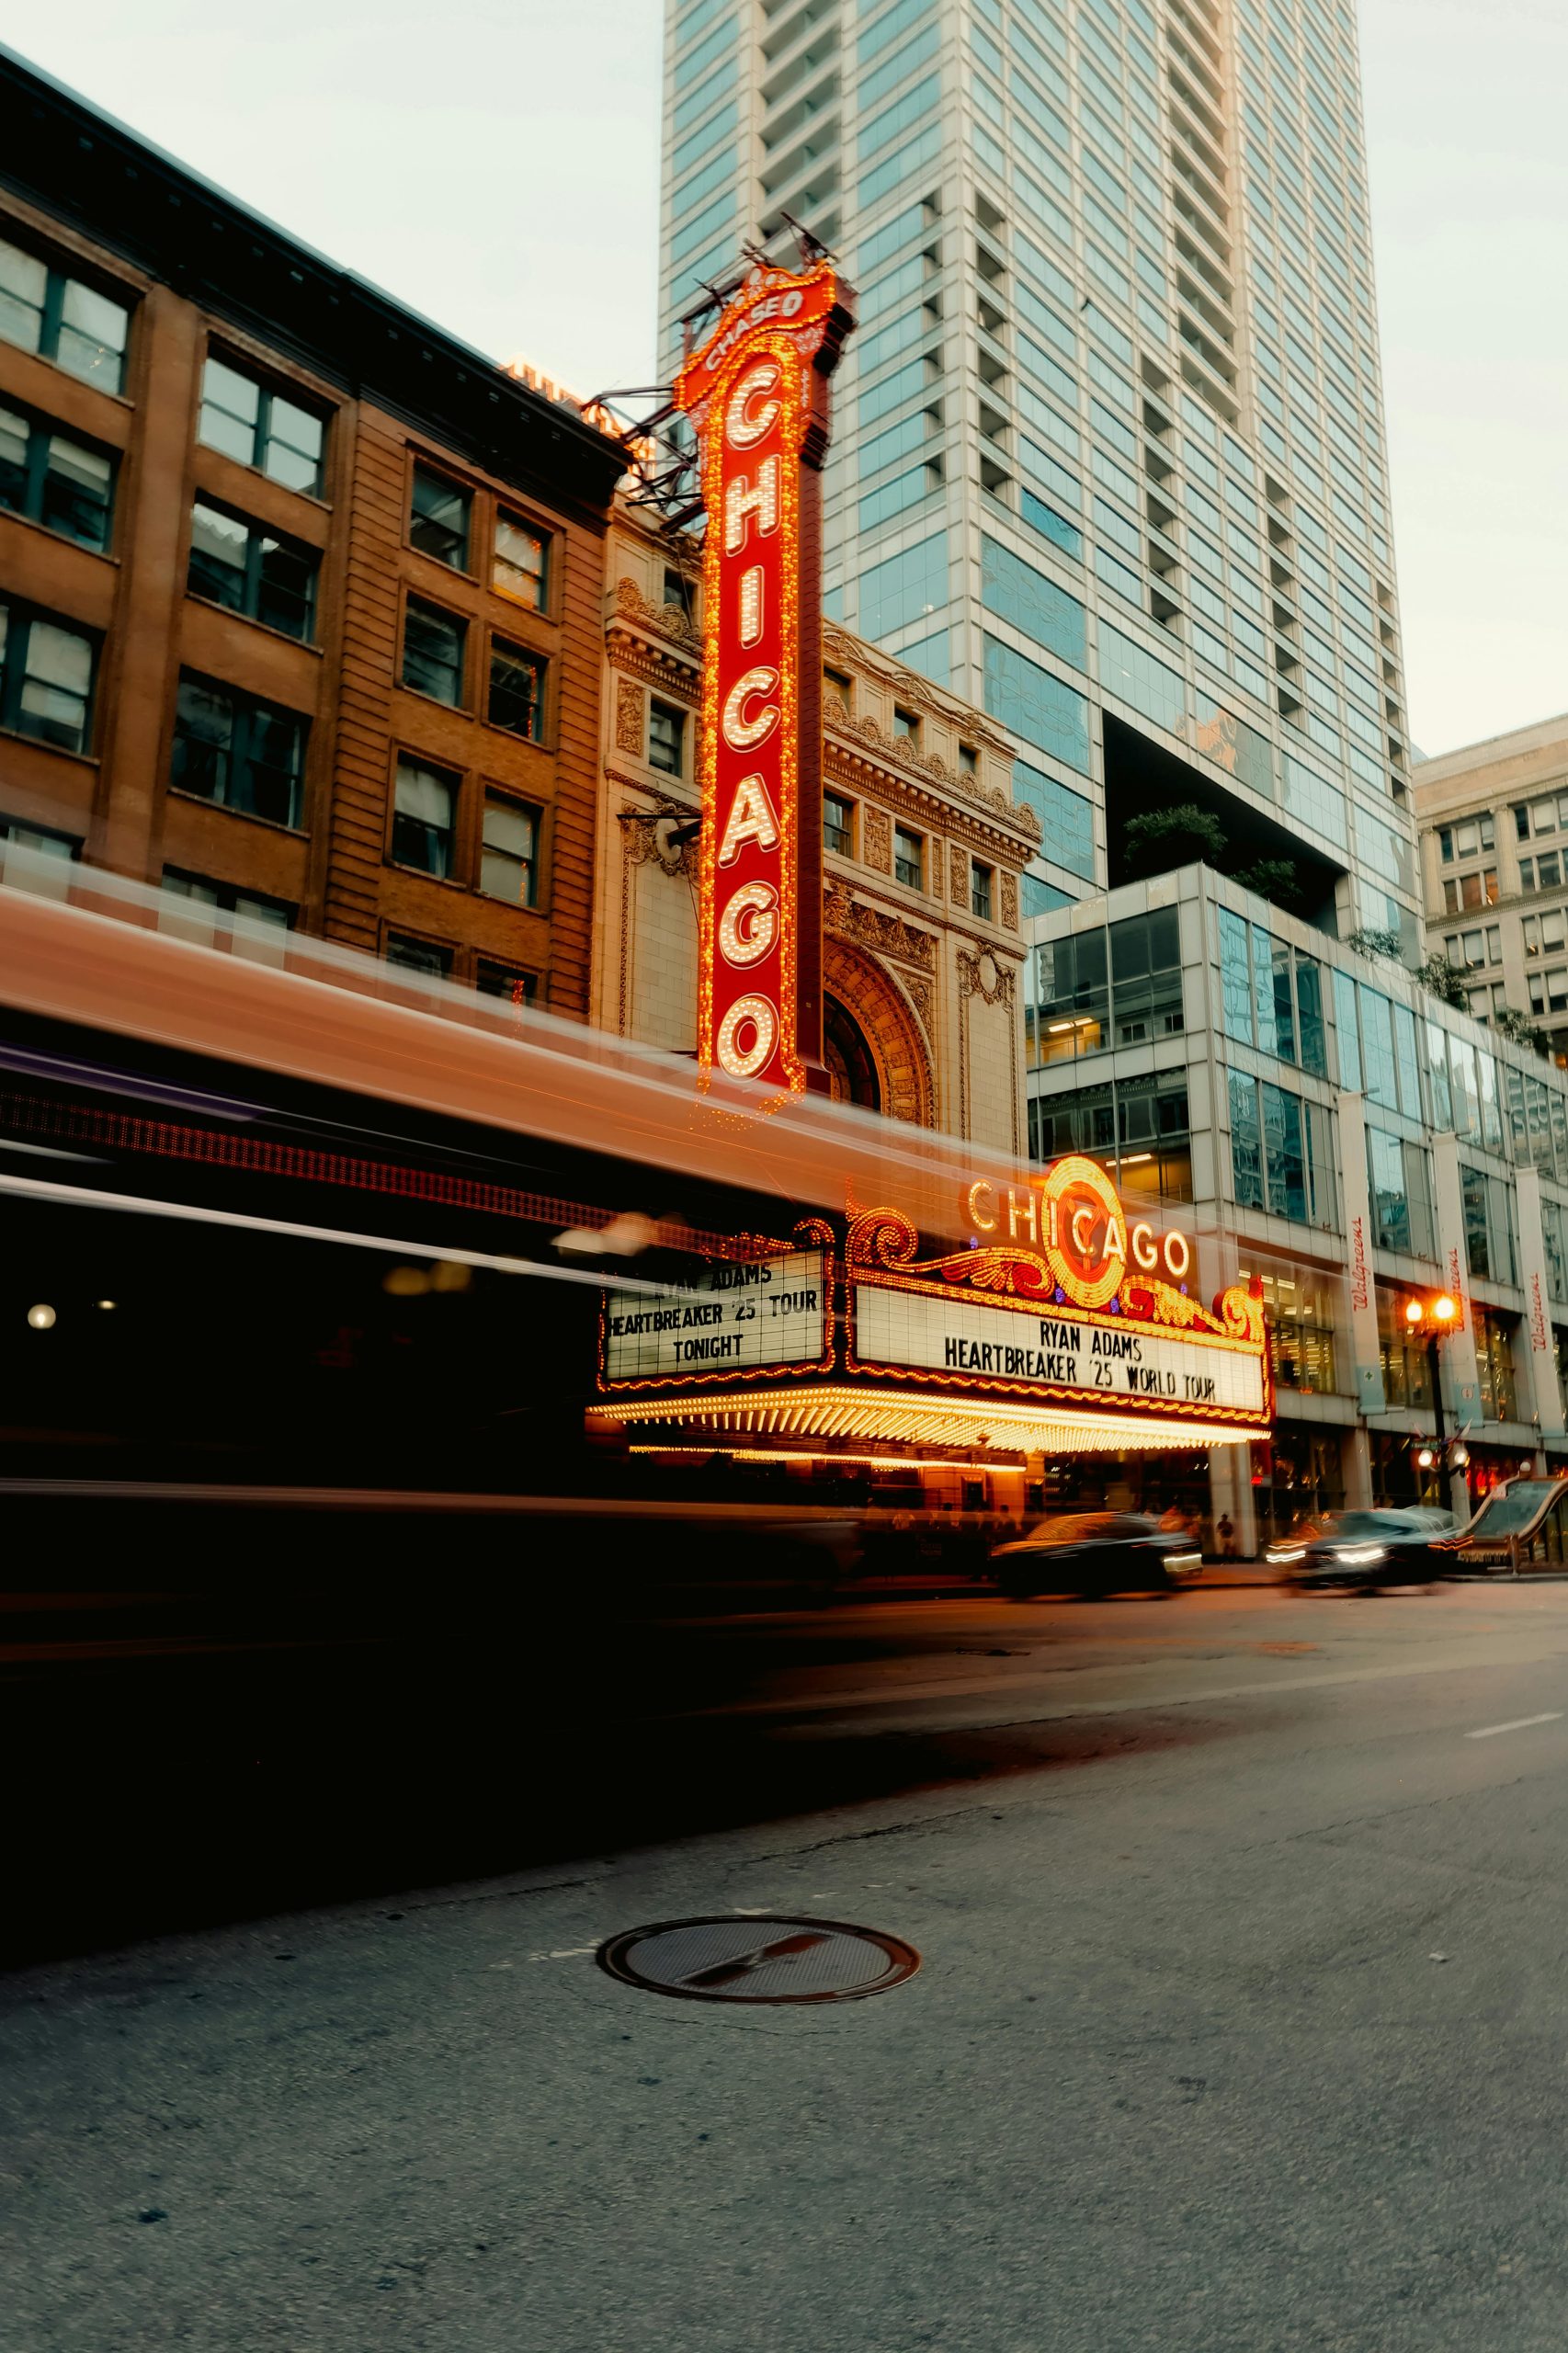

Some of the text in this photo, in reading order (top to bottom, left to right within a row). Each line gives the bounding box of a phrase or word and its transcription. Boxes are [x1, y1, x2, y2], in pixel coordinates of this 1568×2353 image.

[705, 295, 780, 371] CHASE
[717, 364, 782, 1084] CHICAGO
[968, 1178, 1190, 1278] CHICAGO
[710, 1263, 772, 1291] ADAMS
[1351, 1216, 1371, 1313] Walgreens
[608, 1303, 722, 1338] HEARTBREAKER
[768, 1290, 817, 1317] TOUR
[1040, 1321, 1142, 1362] RYAN ADAMS
[1532, 1272, 1548, 1353] Walgreens
[673, 1334, 744, 1363] TONIGHT
[945, 1336, 1216, 1402] HEARTBREAKER '25 WORLD TOUR
